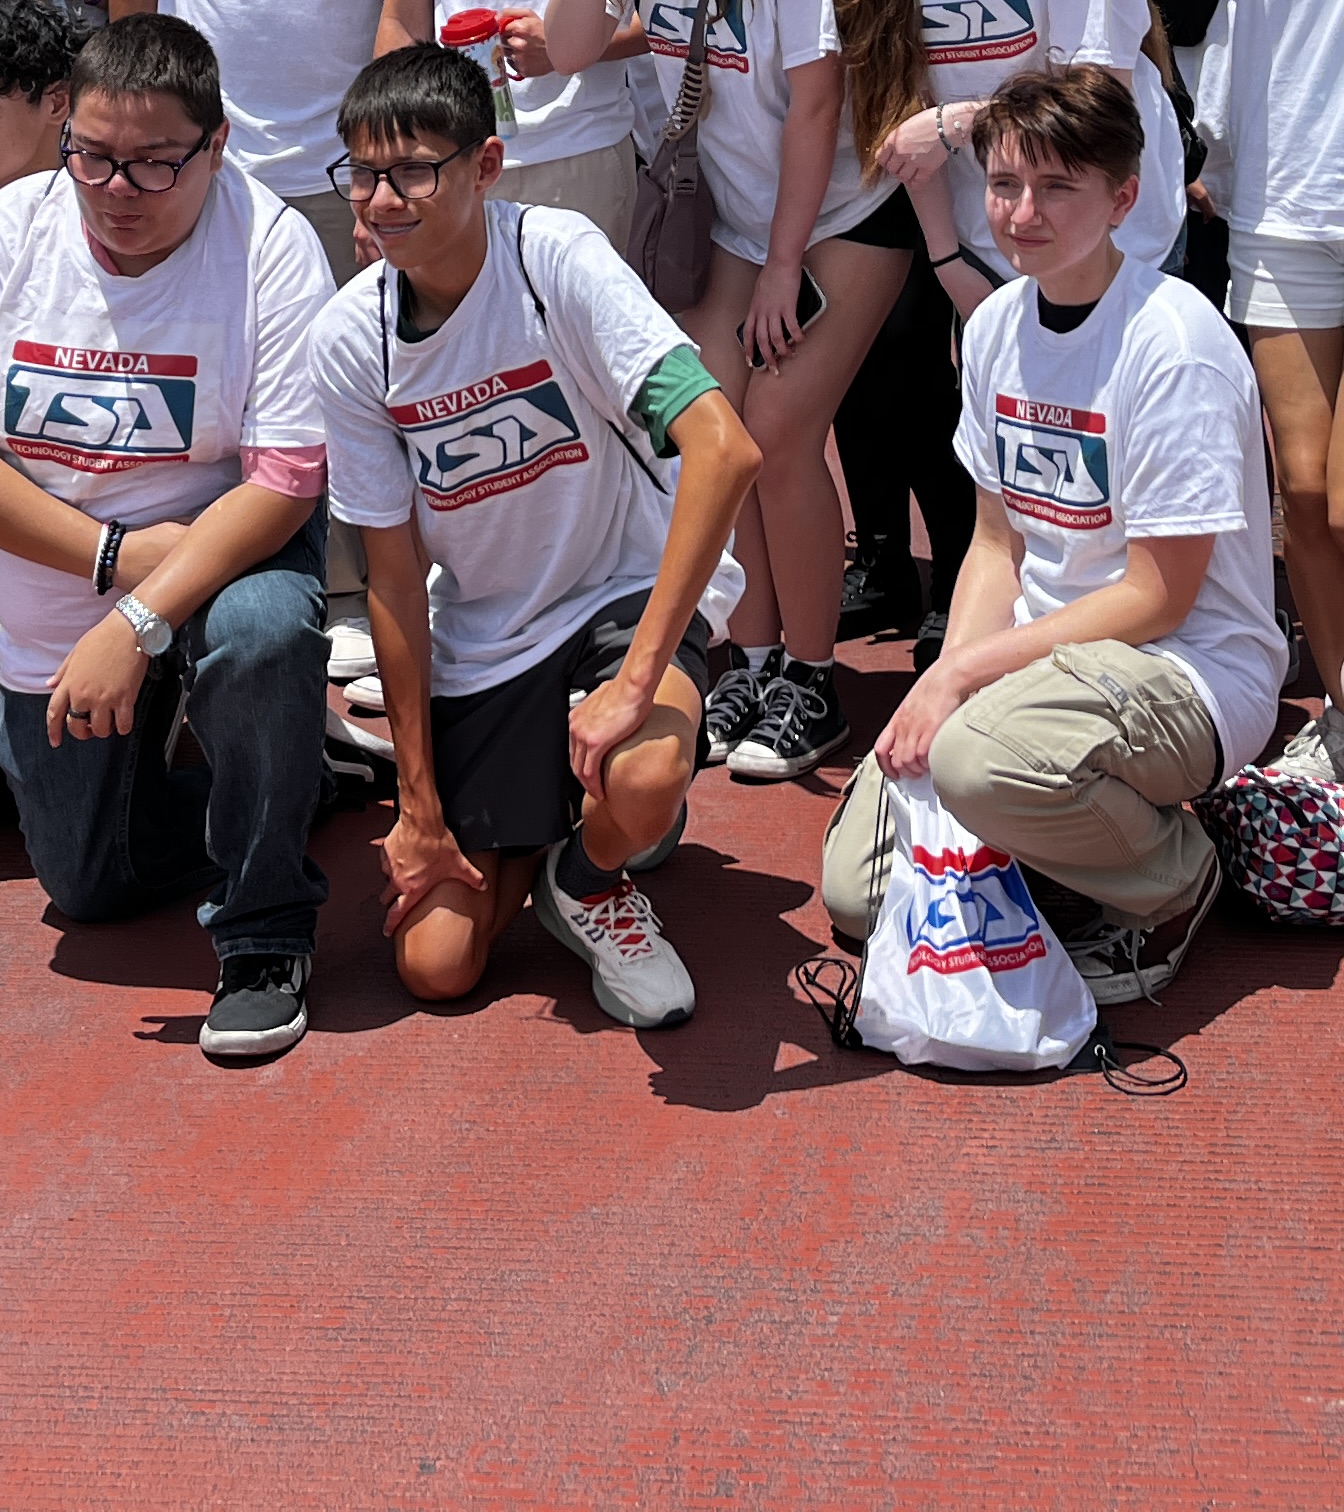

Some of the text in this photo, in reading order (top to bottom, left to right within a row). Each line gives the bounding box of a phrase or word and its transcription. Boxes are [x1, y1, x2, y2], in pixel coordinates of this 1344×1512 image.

[54, 347, 150, 373] NEVADA
[10, 369, 186, 448] TSA
[415, 375, 508, 422] NEVADA
[1015, 399, 1073, 428] NEVADA
[11, 442, 72, 461] TECHNOLOGY
[72, 454, 115, 470] STUDENT
[403, 397, 575, 488] TSA
[996, 421, 1105, 503] TSA
[477, 473, 521, 496] STUDENT
[522, 448, 583, 481] ASSOCIATION
[1055, 511, 1108, 525] ASSOCIATION
